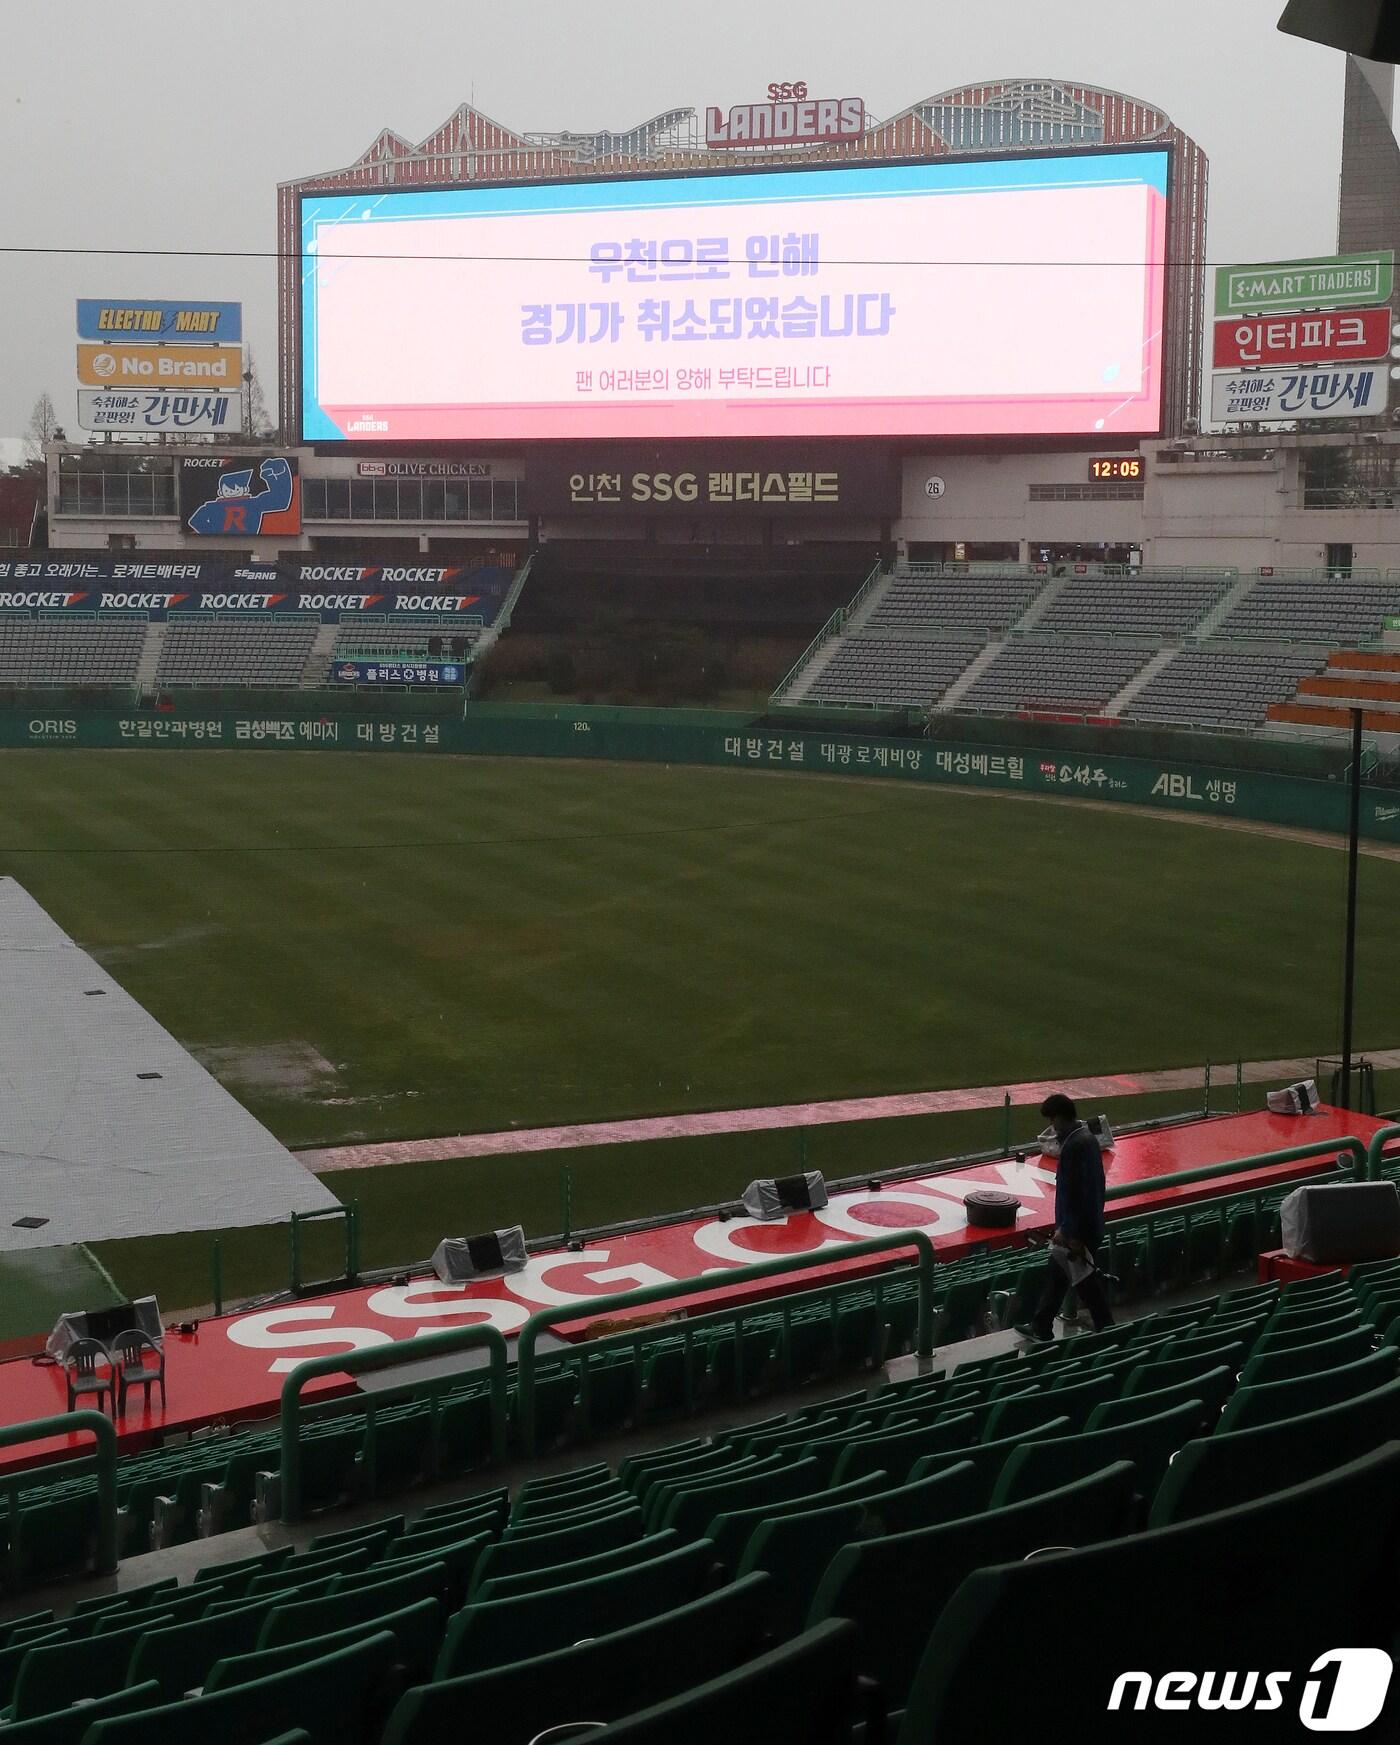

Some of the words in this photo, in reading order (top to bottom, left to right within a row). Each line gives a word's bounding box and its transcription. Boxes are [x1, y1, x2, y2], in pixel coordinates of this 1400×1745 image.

[767, 81, 808, 100] SSG
[706, 98, 863, 144] LANDERS
[589, 237, 731, 283] 우천으로
[745, 233, 819, 278] 인해
[1309, 269, 1372, 291] TRADERS
[98, 309, 163, 331] ELECTRO
[176, 311, 221, 332] MART
[520, 302, 625, 346] 경기가
[637, 292, 896, 342] 취소되었습니다
[1235, 318, 1367, 360] 인터파크
[122, 357, 154, 375] No
[158, 358, 226, 376] Brand
[576, 370, 593, 392] 팬
[599, 369, 669, 392] 여러분의
[676, 367, 711, 391] 양해
[719, 365, 831, 389] 부탁드립니다
[1225, 379, 1275, 394] 숙취해소
[1277, 371, 1374, 412] 간만세
[91, 397, 140, 408] 숙취해소
[142, 396, 229, 426] 간만세
[1227, 396, 1270, 413] 끝판왕!
[93, 411, 136, 424] 끝판왕!
[347, 421, 389, 432] LANDERS
[184, 458, 226, 467] ROCKET
[388, 463, 427, 475] OLIVE
[429, 464, 487, 475] CHICKEN
[1093, 462, 1139, 477] 12:05
[569, 473, 621, 501] 인천
[632, 473, 698, 501] SSG
[708, 473, 839, 501] 랜더스필드
[928, 482, 940, 494] 26
[14, 563, 42, 578] 좋고
[112, 564, 201, 579] 로케트배터리
[234, 569, 277, 580] SEBANG
[300, 567, 366, 581] ROCKET
[381, 568, 447, 582] ROCKET
[0, 592, 74, 607] ROCKET
[100, 593, 175, 608] ROCKET
[200, 593, 273, 608] ROCKET
[298, 594, 370, 609] ROCKET
[395, 595, 466, 610] ROCKET
[367, 668, 401, 680] 플러스
[416, 669, 439, 681] 병원
[29, 720, 77, 734] ORIS
[119, 720, 222, 738] 한길안과병원
[235, 720, 295, 740] 금성백조
[299, 721, 338, 741] 예미지
[357, 723, 439, 744] 대방건설
[724, 736, 804, 761] 대방건설
[821, 743, 922, 770] 대광로제비앙
[936, 750, 1024, 780] 대성베르힐
[1059, 764, 1108, 787] 소성주
[1152, 773, 1203, 800] ABL
[1205, 779, 1237, 804] 생명
